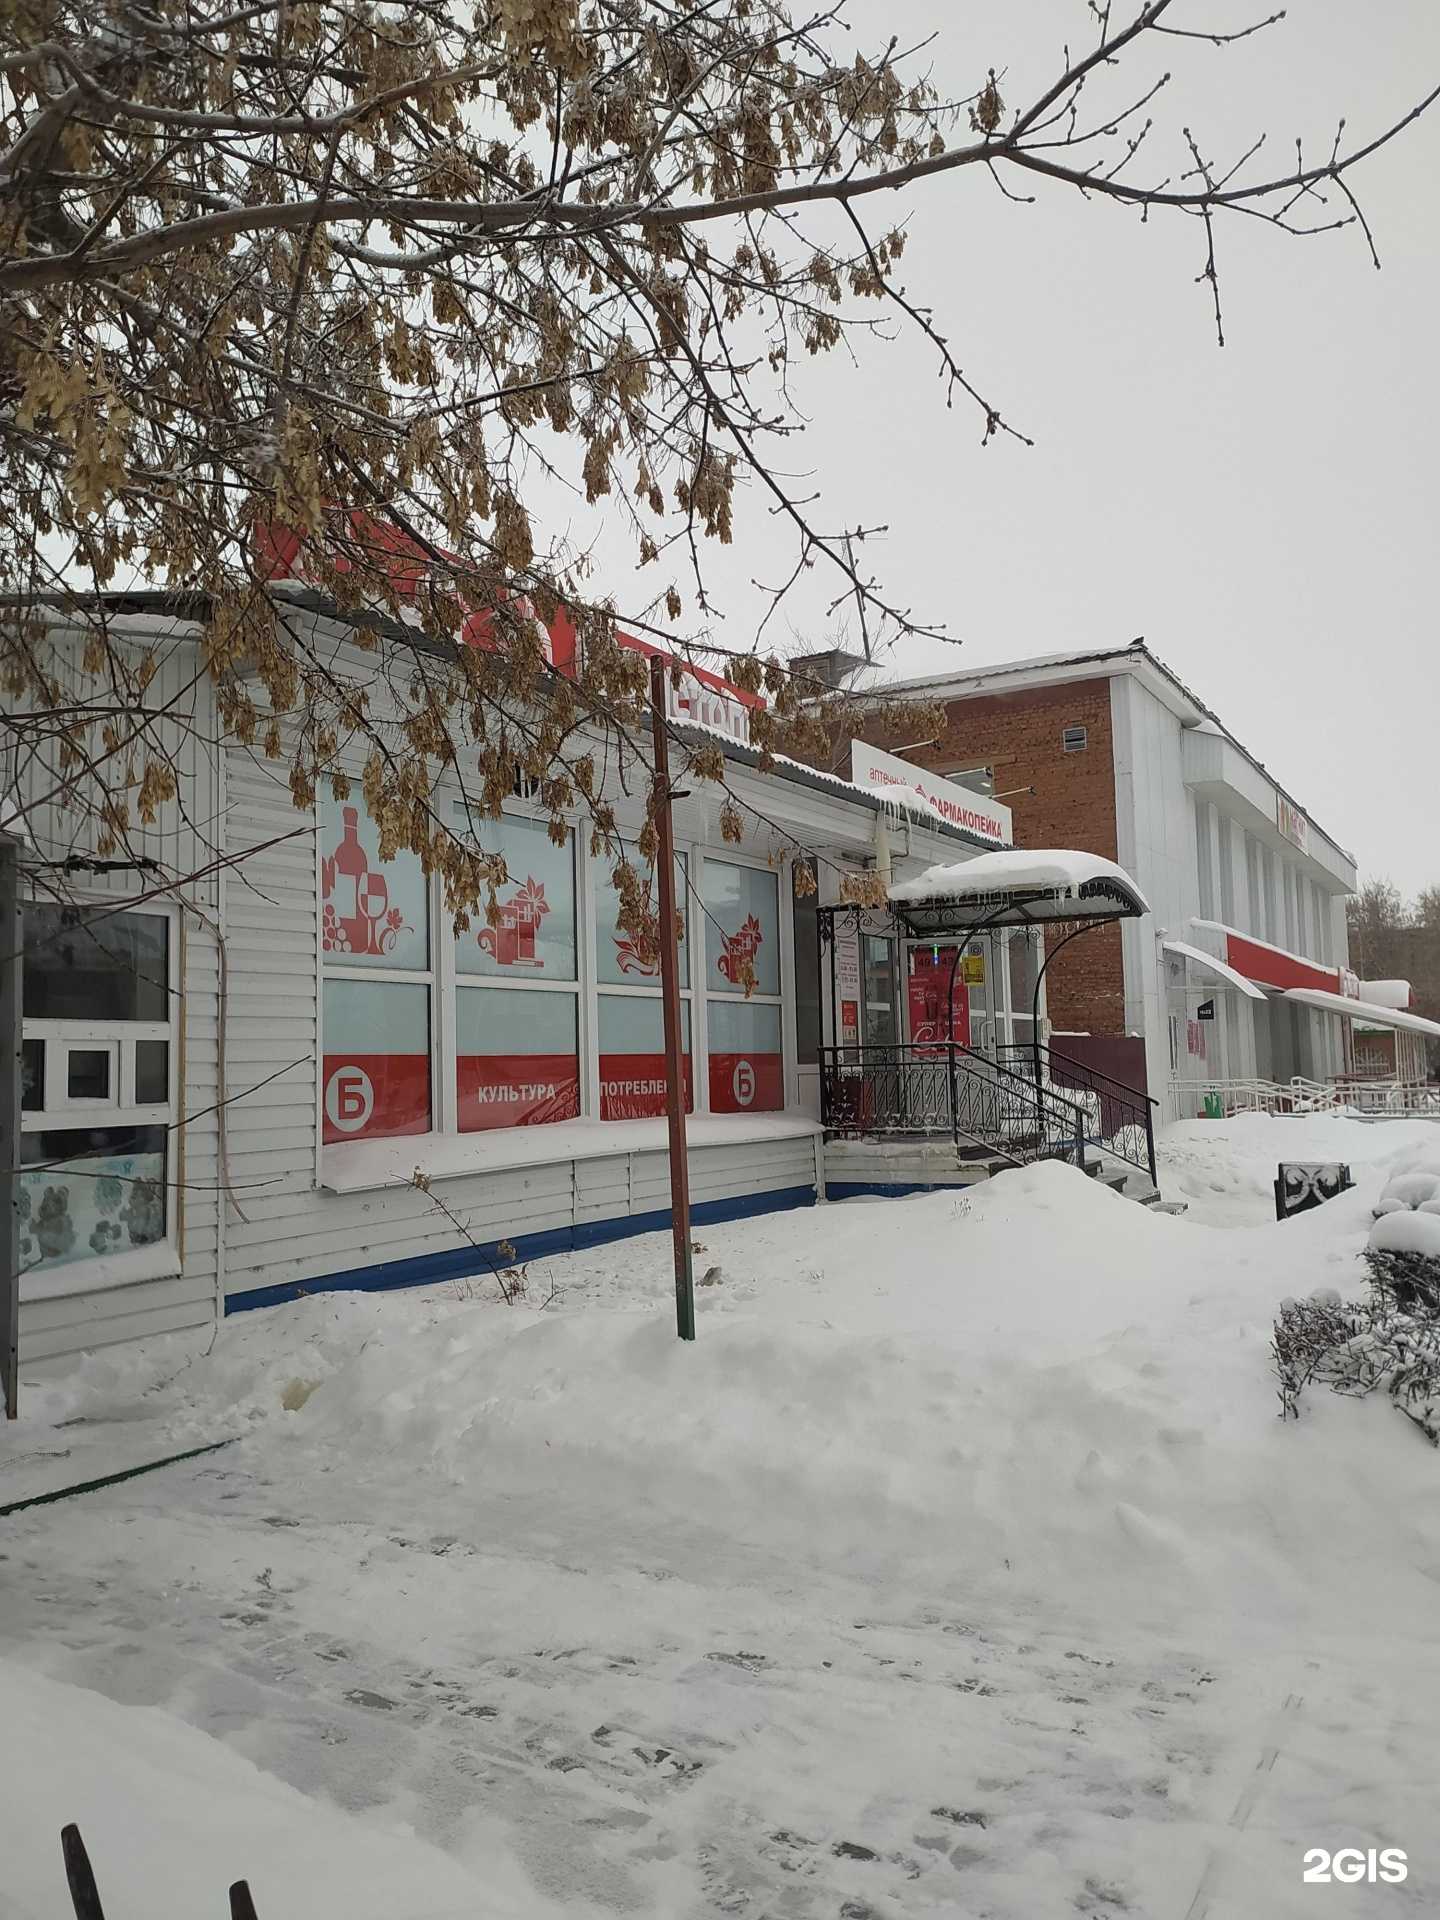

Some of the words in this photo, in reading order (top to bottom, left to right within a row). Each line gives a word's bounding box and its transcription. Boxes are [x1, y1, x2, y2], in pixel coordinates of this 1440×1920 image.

[337, 1077, 366, 1120] Б
[478, 1084, 556, 1104] КУЛЬТУРА
[600, 1080, 687, 1097] ПОТРЕБЛЕ
